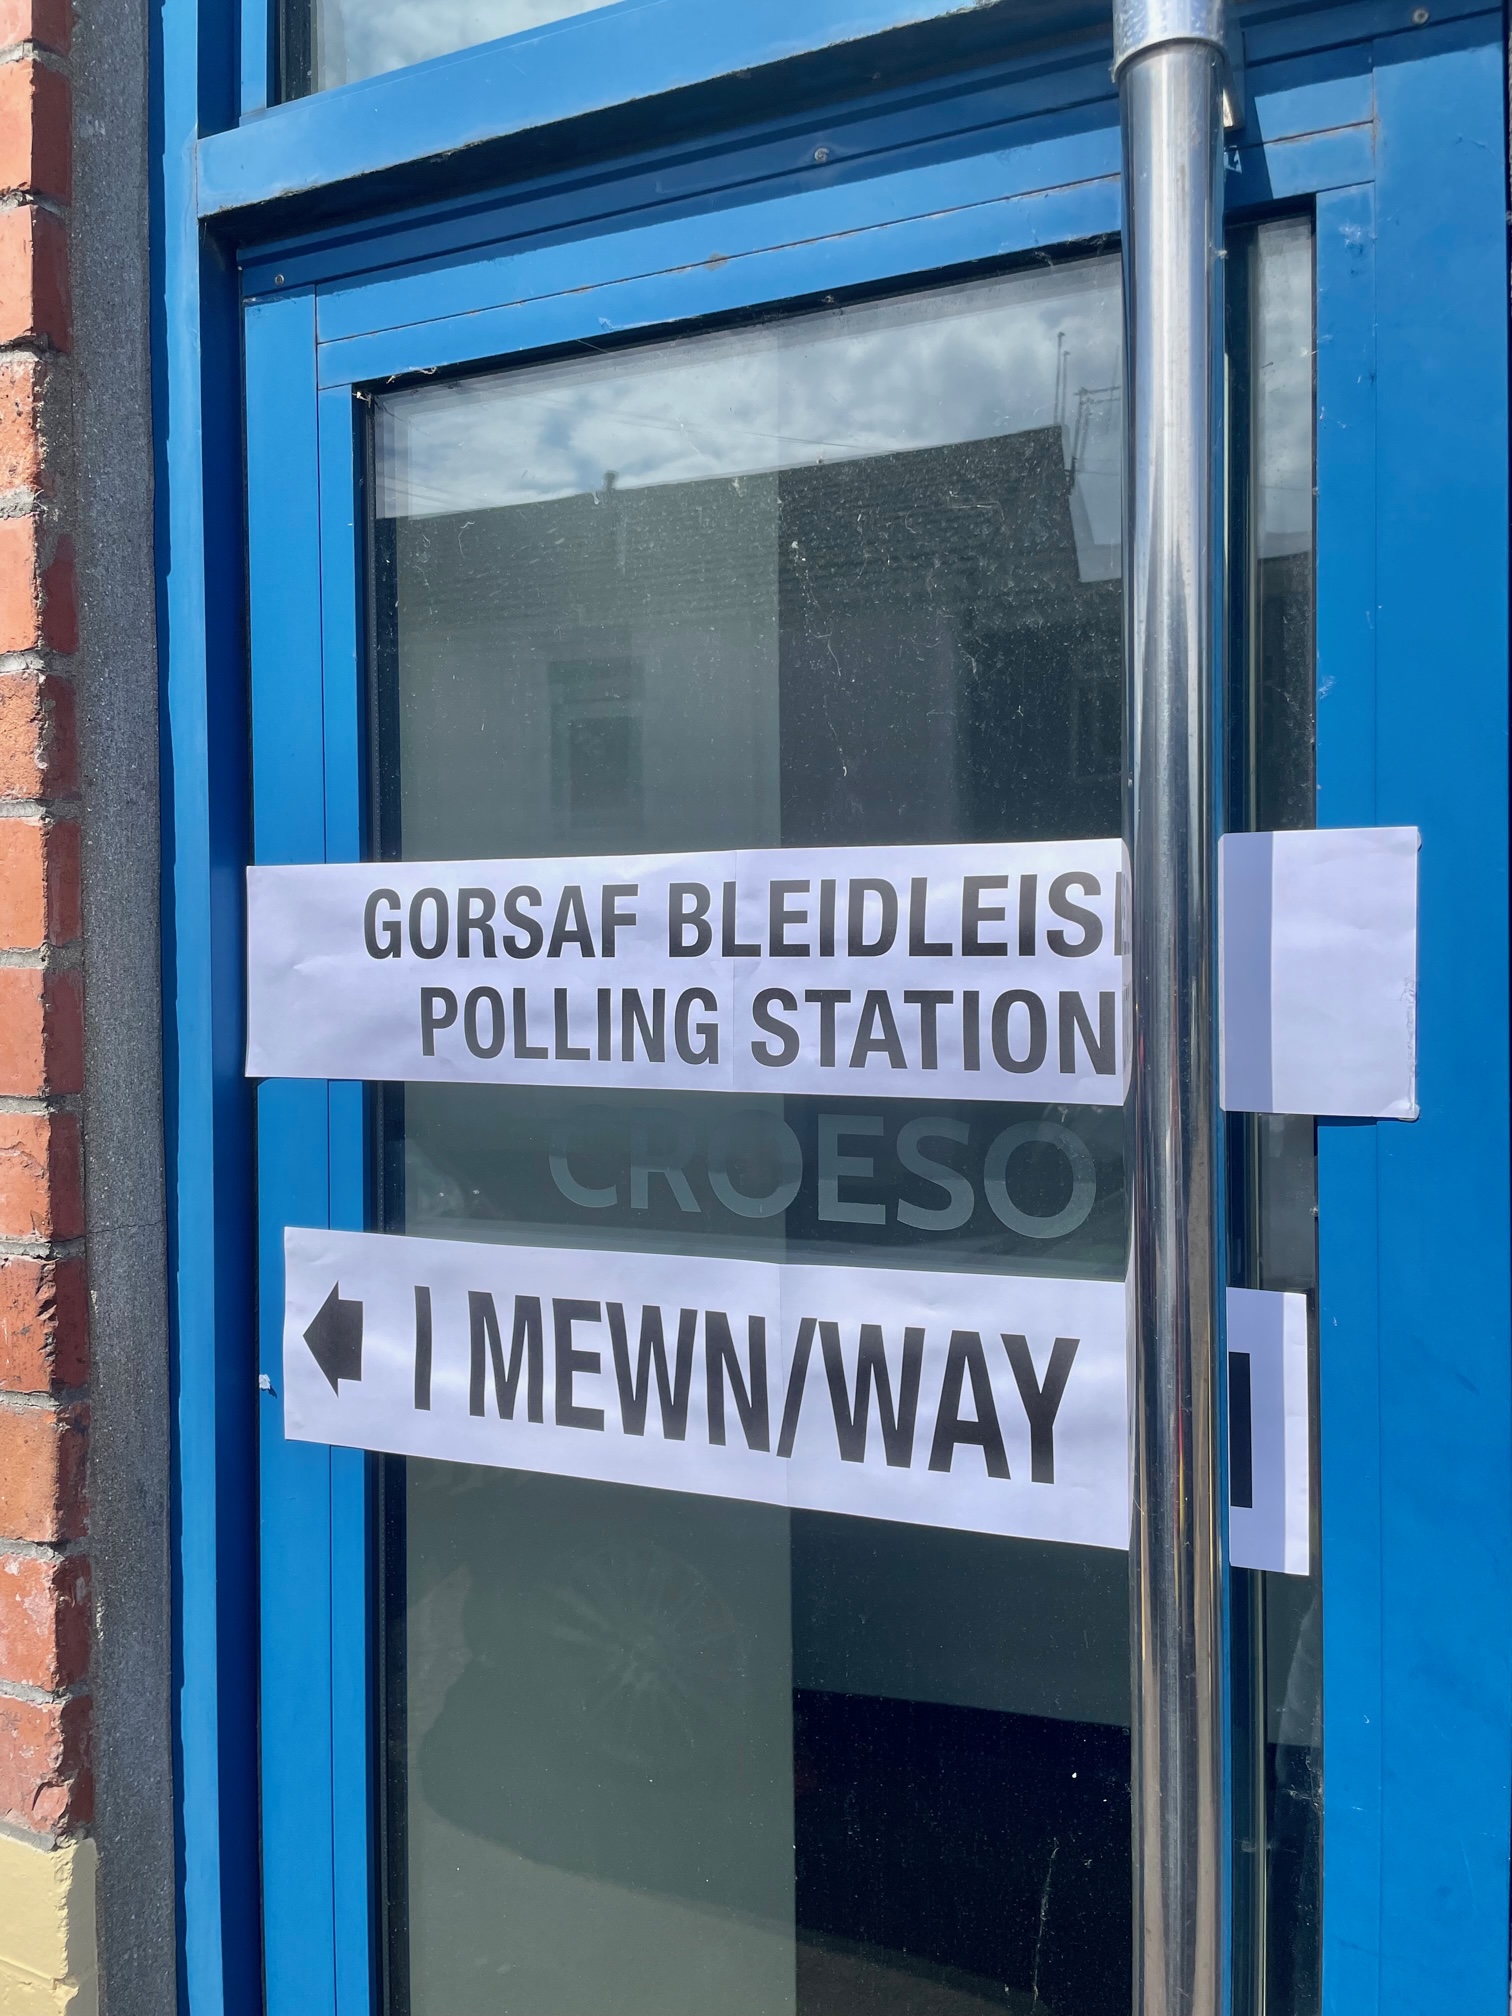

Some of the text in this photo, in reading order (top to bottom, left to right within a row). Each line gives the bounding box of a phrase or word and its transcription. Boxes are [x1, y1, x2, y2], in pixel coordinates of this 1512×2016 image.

[363, 884, 639, 959] GORSAF
[420, 986, 1117, 1075] POLLING STATION
[549, 1104, 1097, 1239] CROESO
[414, 1285, 431, 1411] I
[468, 1290, 1081, 1485] MEWN/WAY
